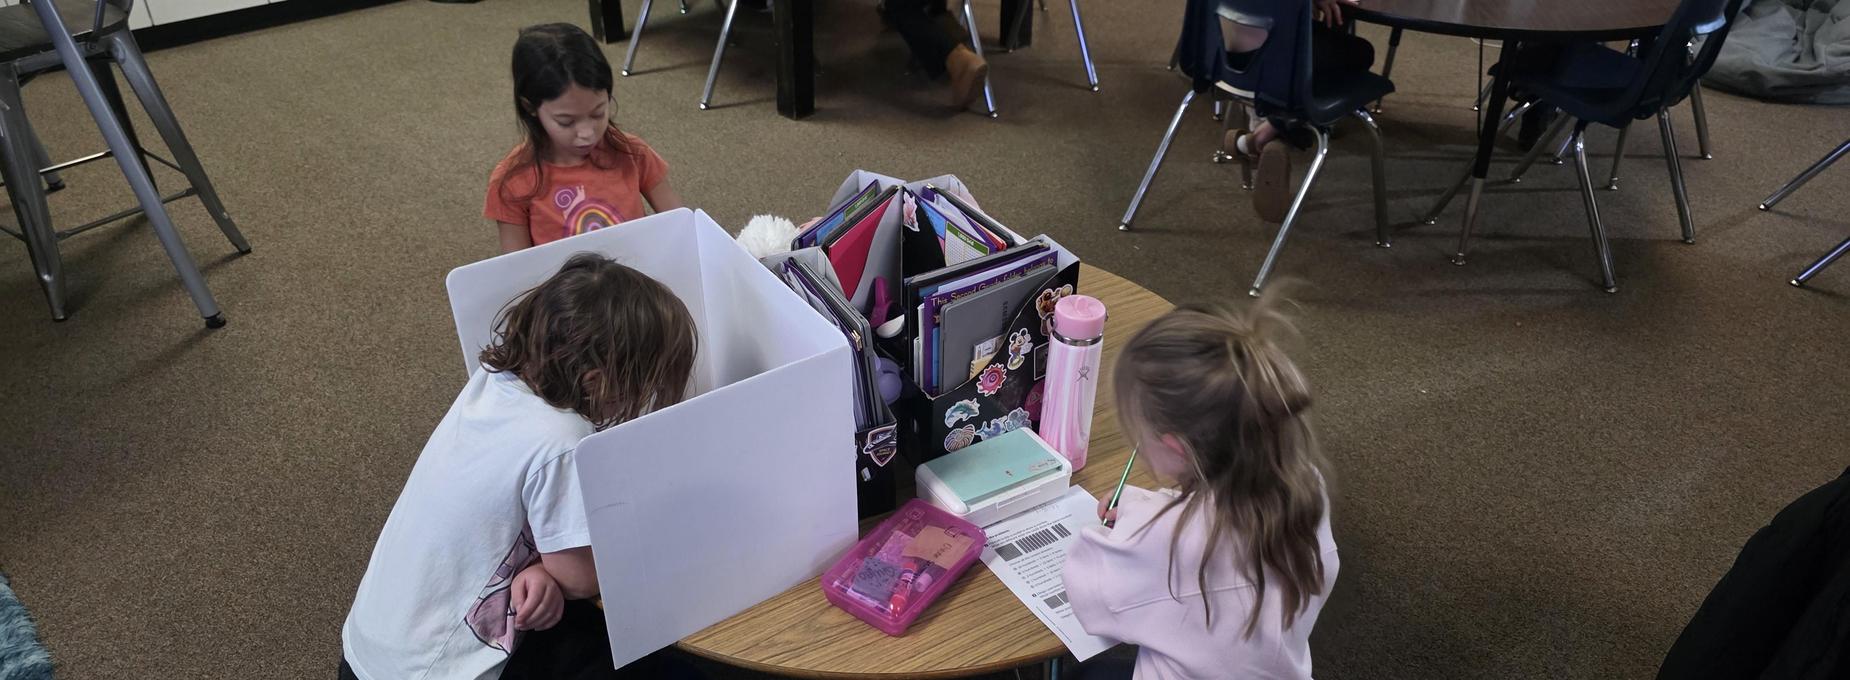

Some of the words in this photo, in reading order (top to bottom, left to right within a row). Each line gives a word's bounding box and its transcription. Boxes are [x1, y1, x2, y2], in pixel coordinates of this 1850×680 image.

[931, 297, 948, 307] This
[951, 286, 977, 301] Second
[1047, 257, 1054, 265] to
